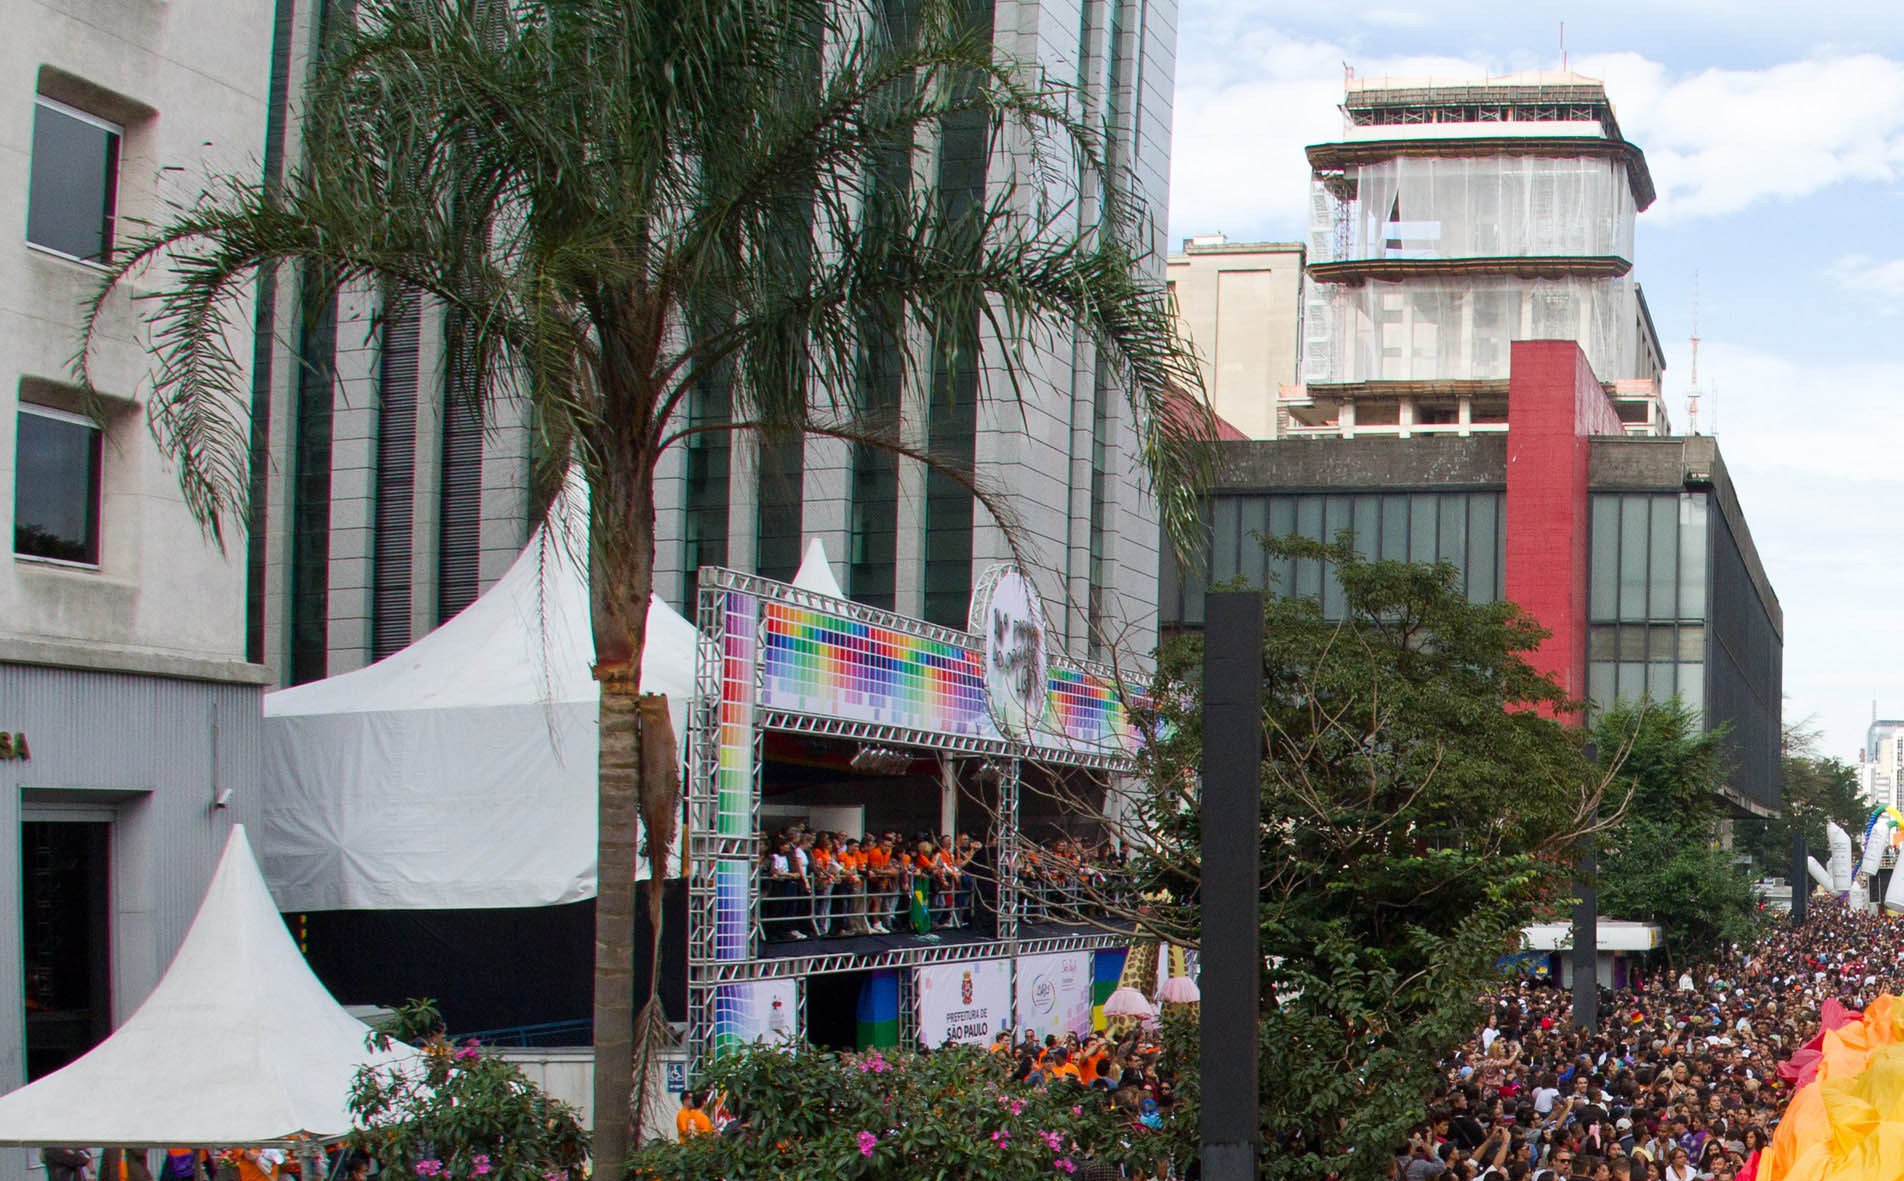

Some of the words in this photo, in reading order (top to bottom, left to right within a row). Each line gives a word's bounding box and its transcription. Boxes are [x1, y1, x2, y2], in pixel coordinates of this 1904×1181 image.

[946, 1009, 979, 1023] PREFEITURA
[980, 1008, 988, 1018] DE
[947, 1024, 962, 1040] SÃO
[964, 1022, 988, 1038] PAULO
